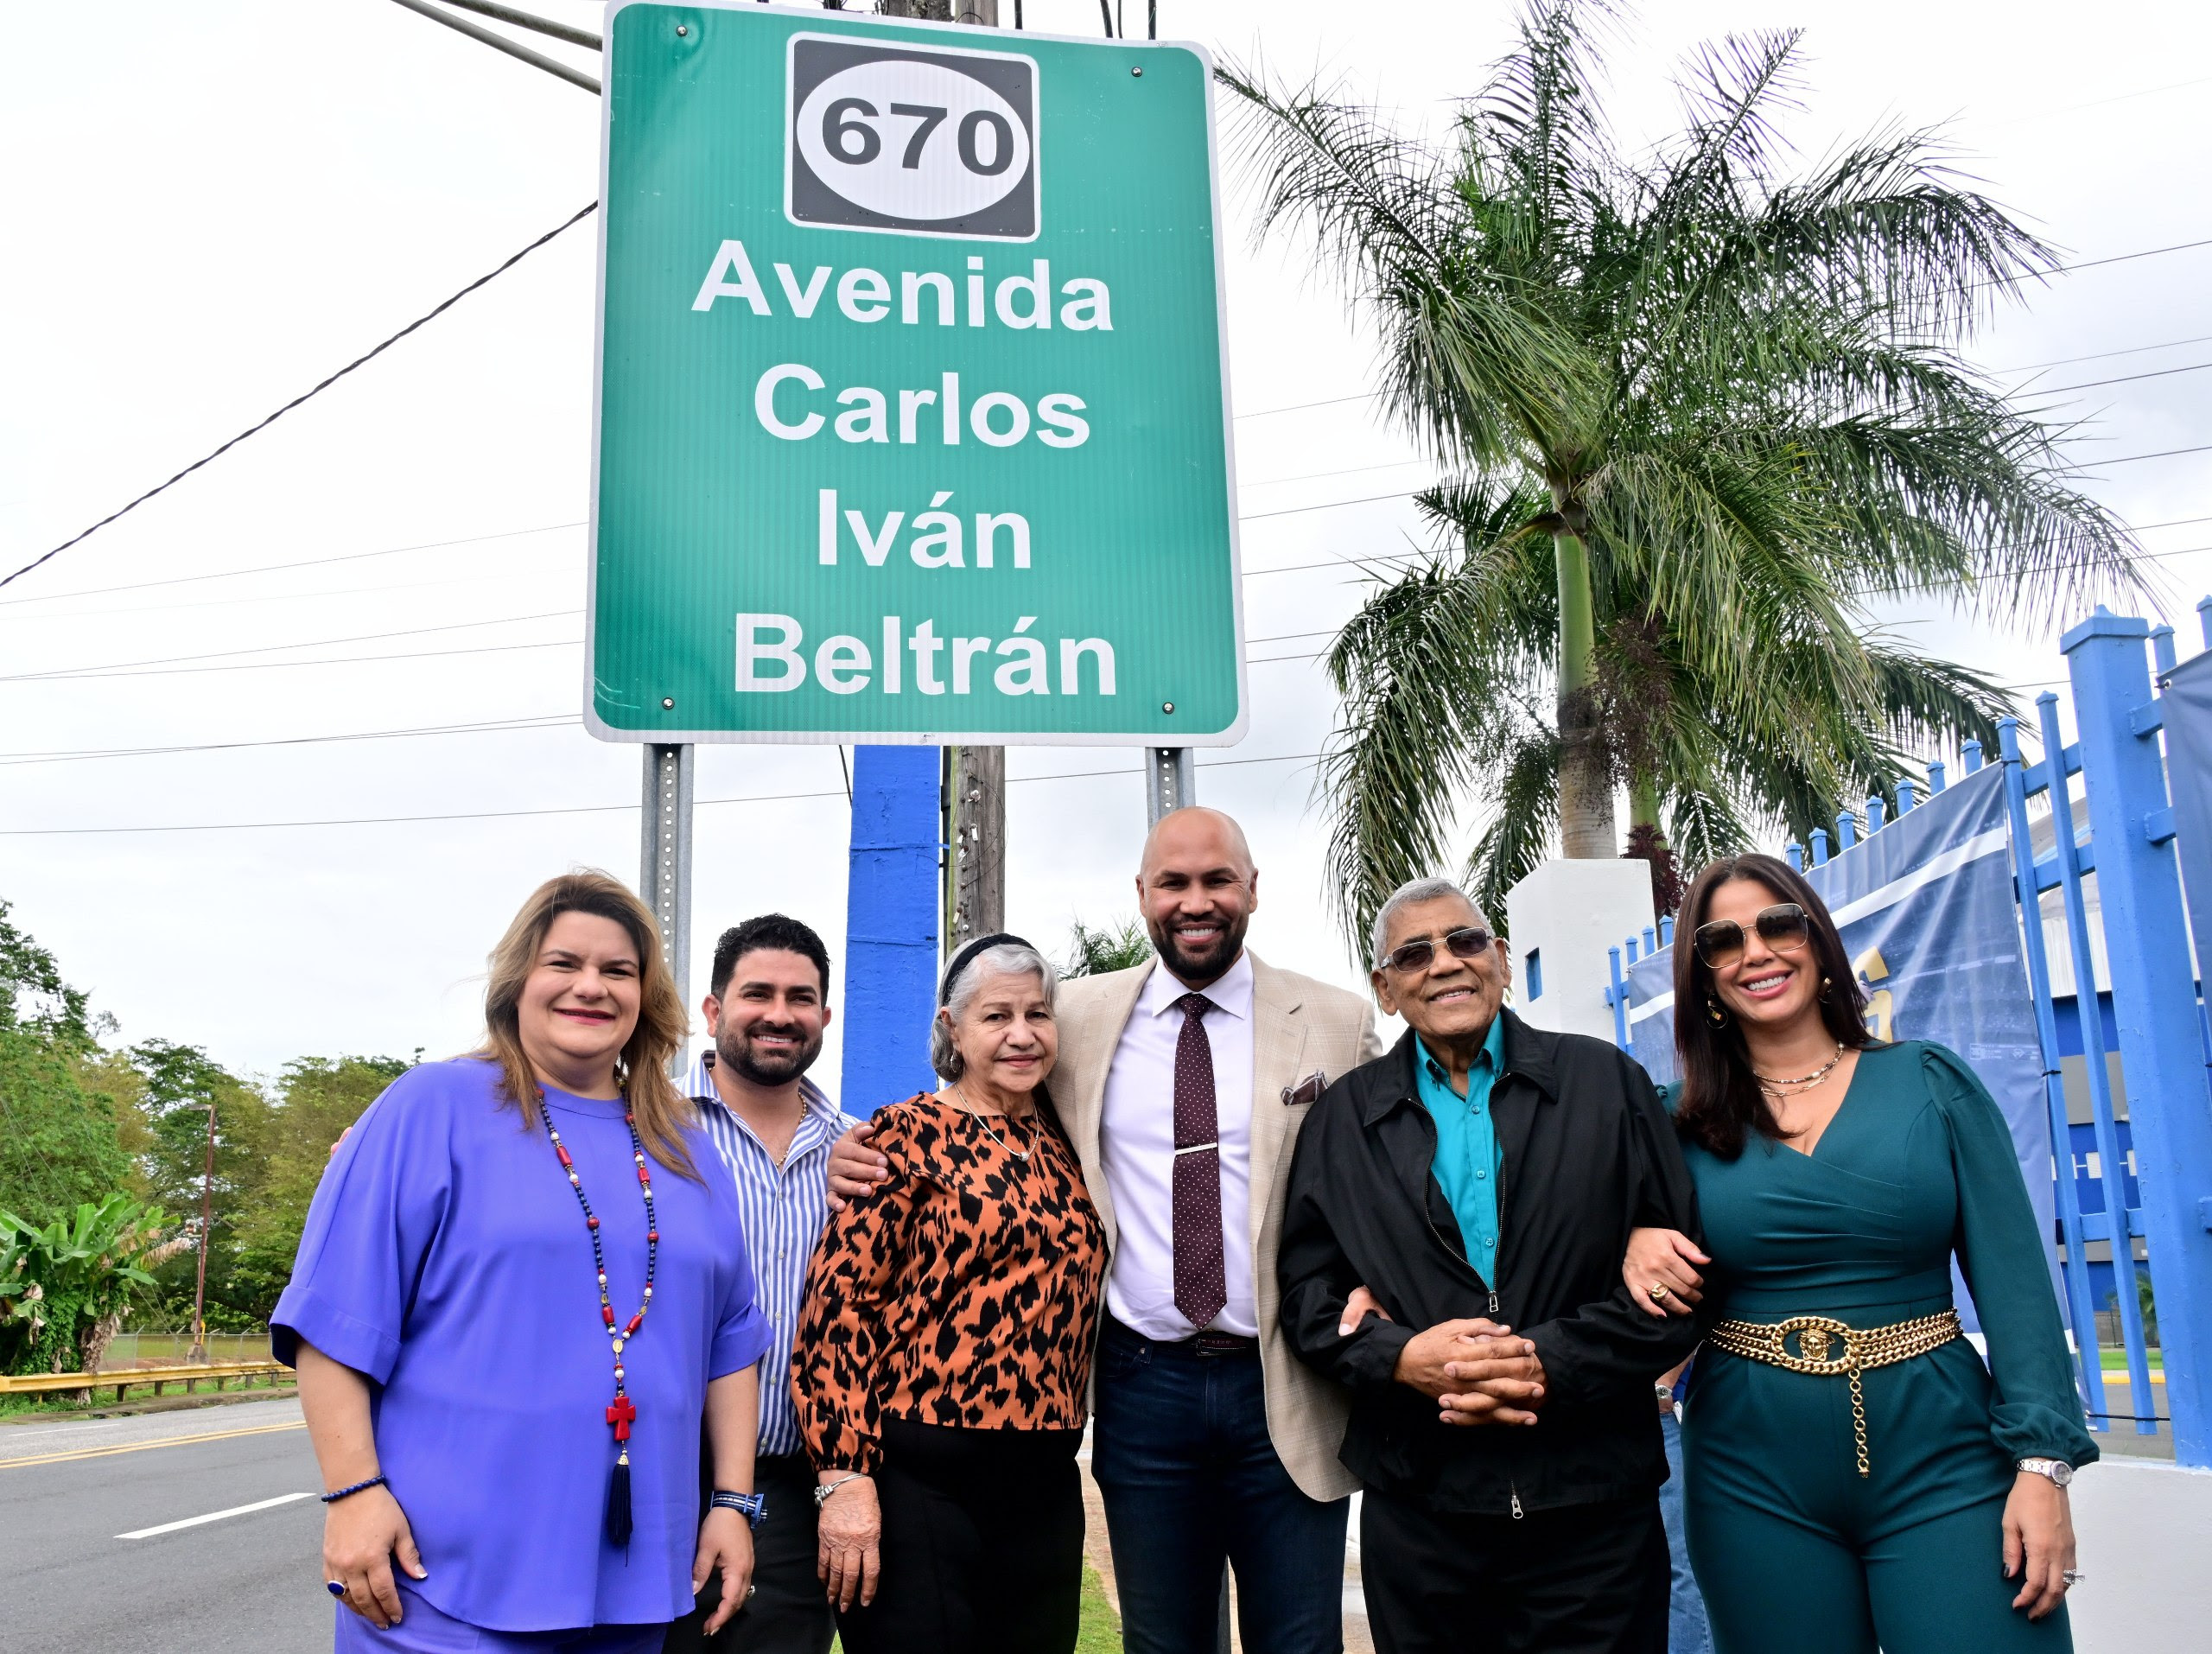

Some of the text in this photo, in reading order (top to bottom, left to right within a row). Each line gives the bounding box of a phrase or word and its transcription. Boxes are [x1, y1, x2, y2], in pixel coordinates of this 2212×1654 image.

[823, 98, 1014, 175] 670
[691, 239, 1113, 330] Avenida
[755, 364, 1090, 448] Carlos
[819, 489, 1030, 568] Iván
[735, 614, 1116, 696] Beltrán
